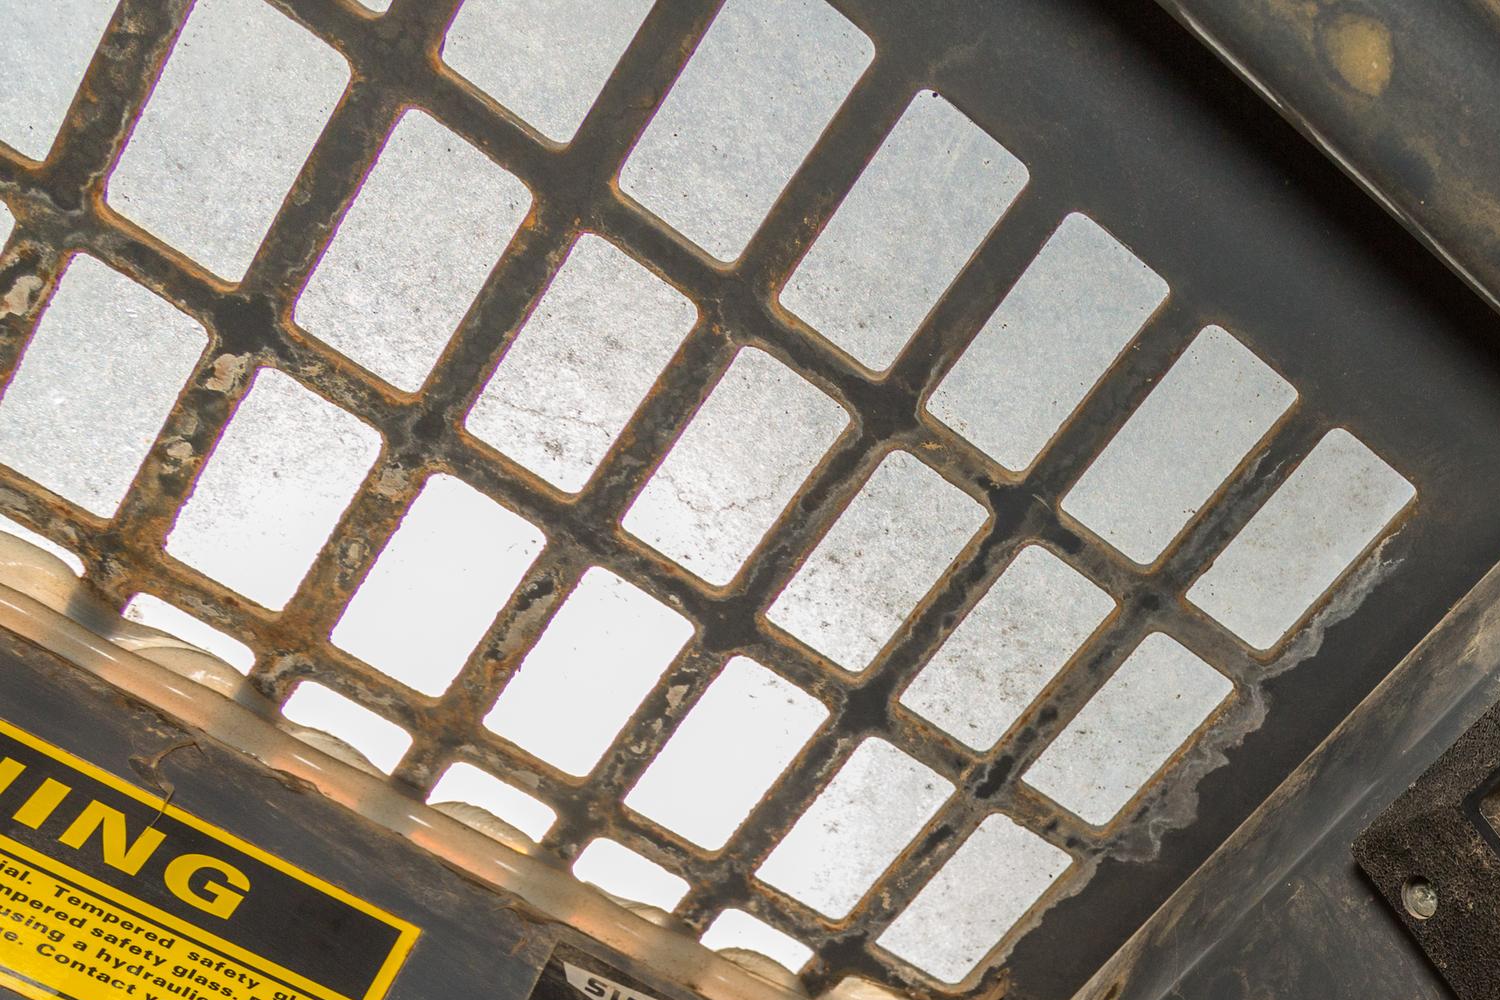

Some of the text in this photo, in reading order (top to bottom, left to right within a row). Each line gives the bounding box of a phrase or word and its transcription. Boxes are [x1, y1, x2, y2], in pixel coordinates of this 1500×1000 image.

[36, 943, 138, 995] Contact
[54, 885, 176, 949] Tempered
[187, 951, 260, 990] safety
[73, 940, 88, 951] a
[90, 926, 168, 967] safety
[172, 964, 238, 1000] glass.
